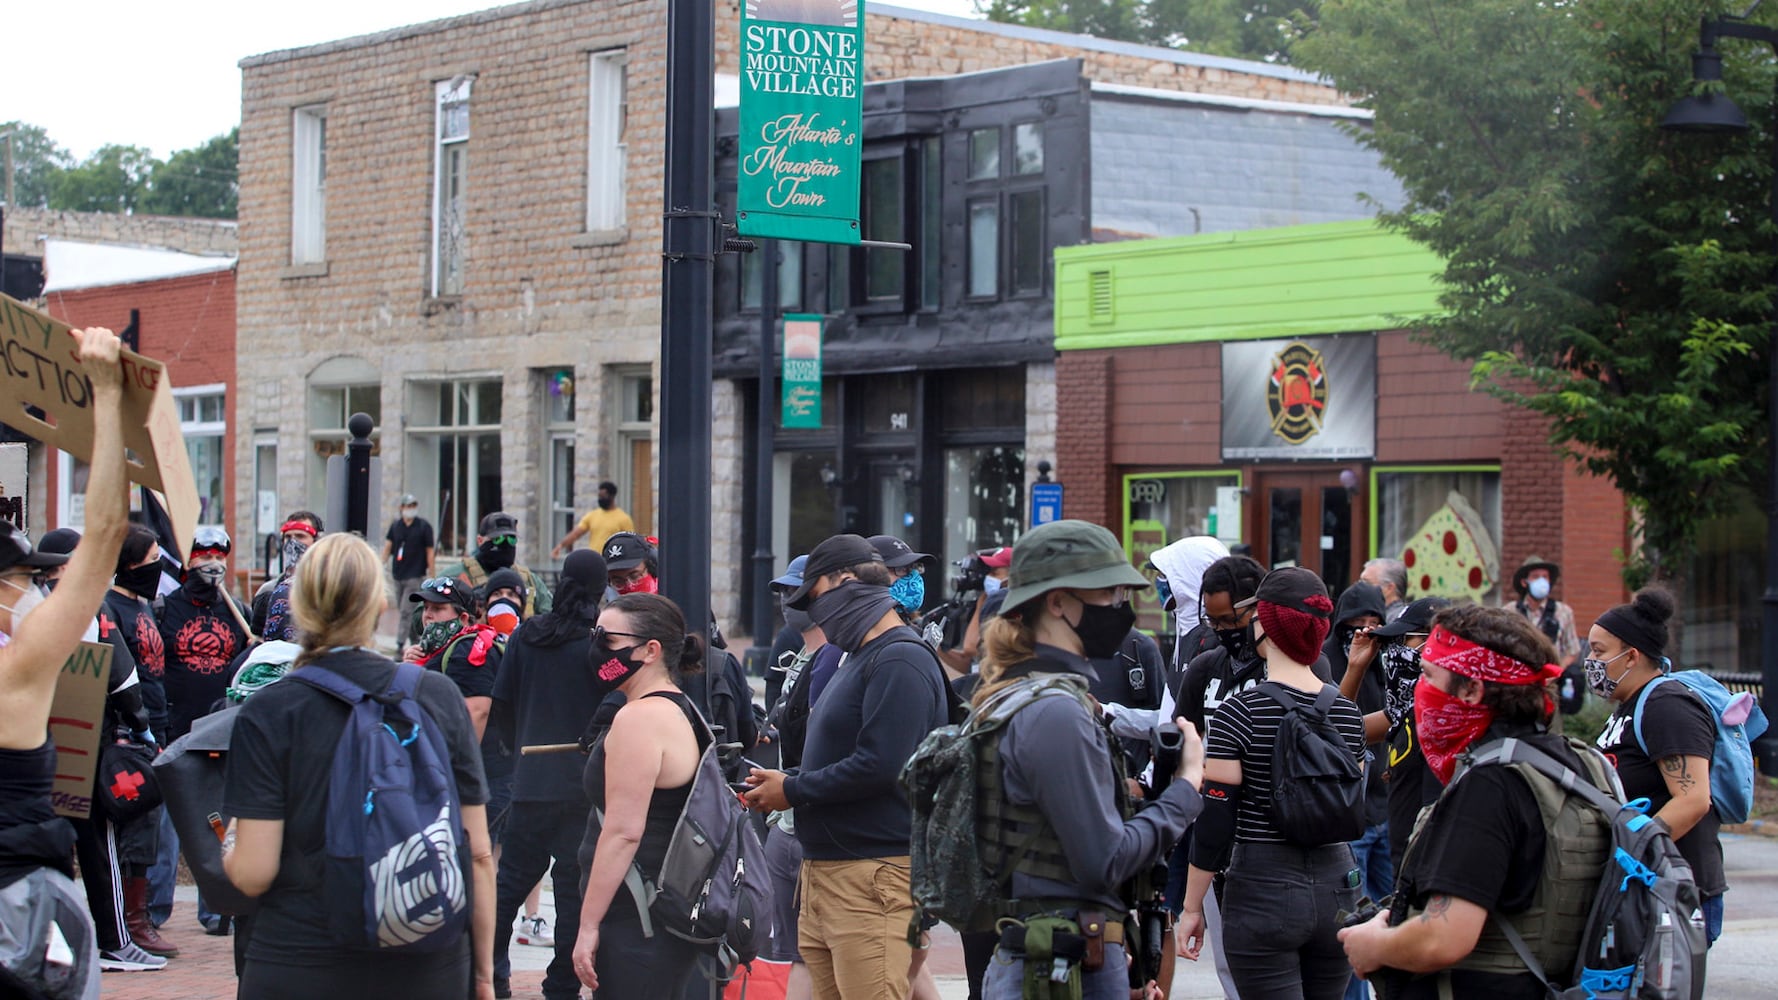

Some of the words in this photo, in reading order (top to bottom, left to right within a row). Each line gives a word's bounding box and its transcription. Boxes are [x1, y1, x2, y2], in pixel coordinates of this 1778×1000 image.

[746, 25, 856, 59] STONE
[746, 53, 857, 77] MOUNTAIN
[746, 70, 856, 98] VILLAGE
[762, 113, 855, 147] Atlanta's
[743, 145, 841, 180] Mountain
[767, 176, 826, 208] Town
[0, 298, 52, 350] ITY
[890, 412, 907, 430] 941
[1130, 483, 1162, 504] OPEN
